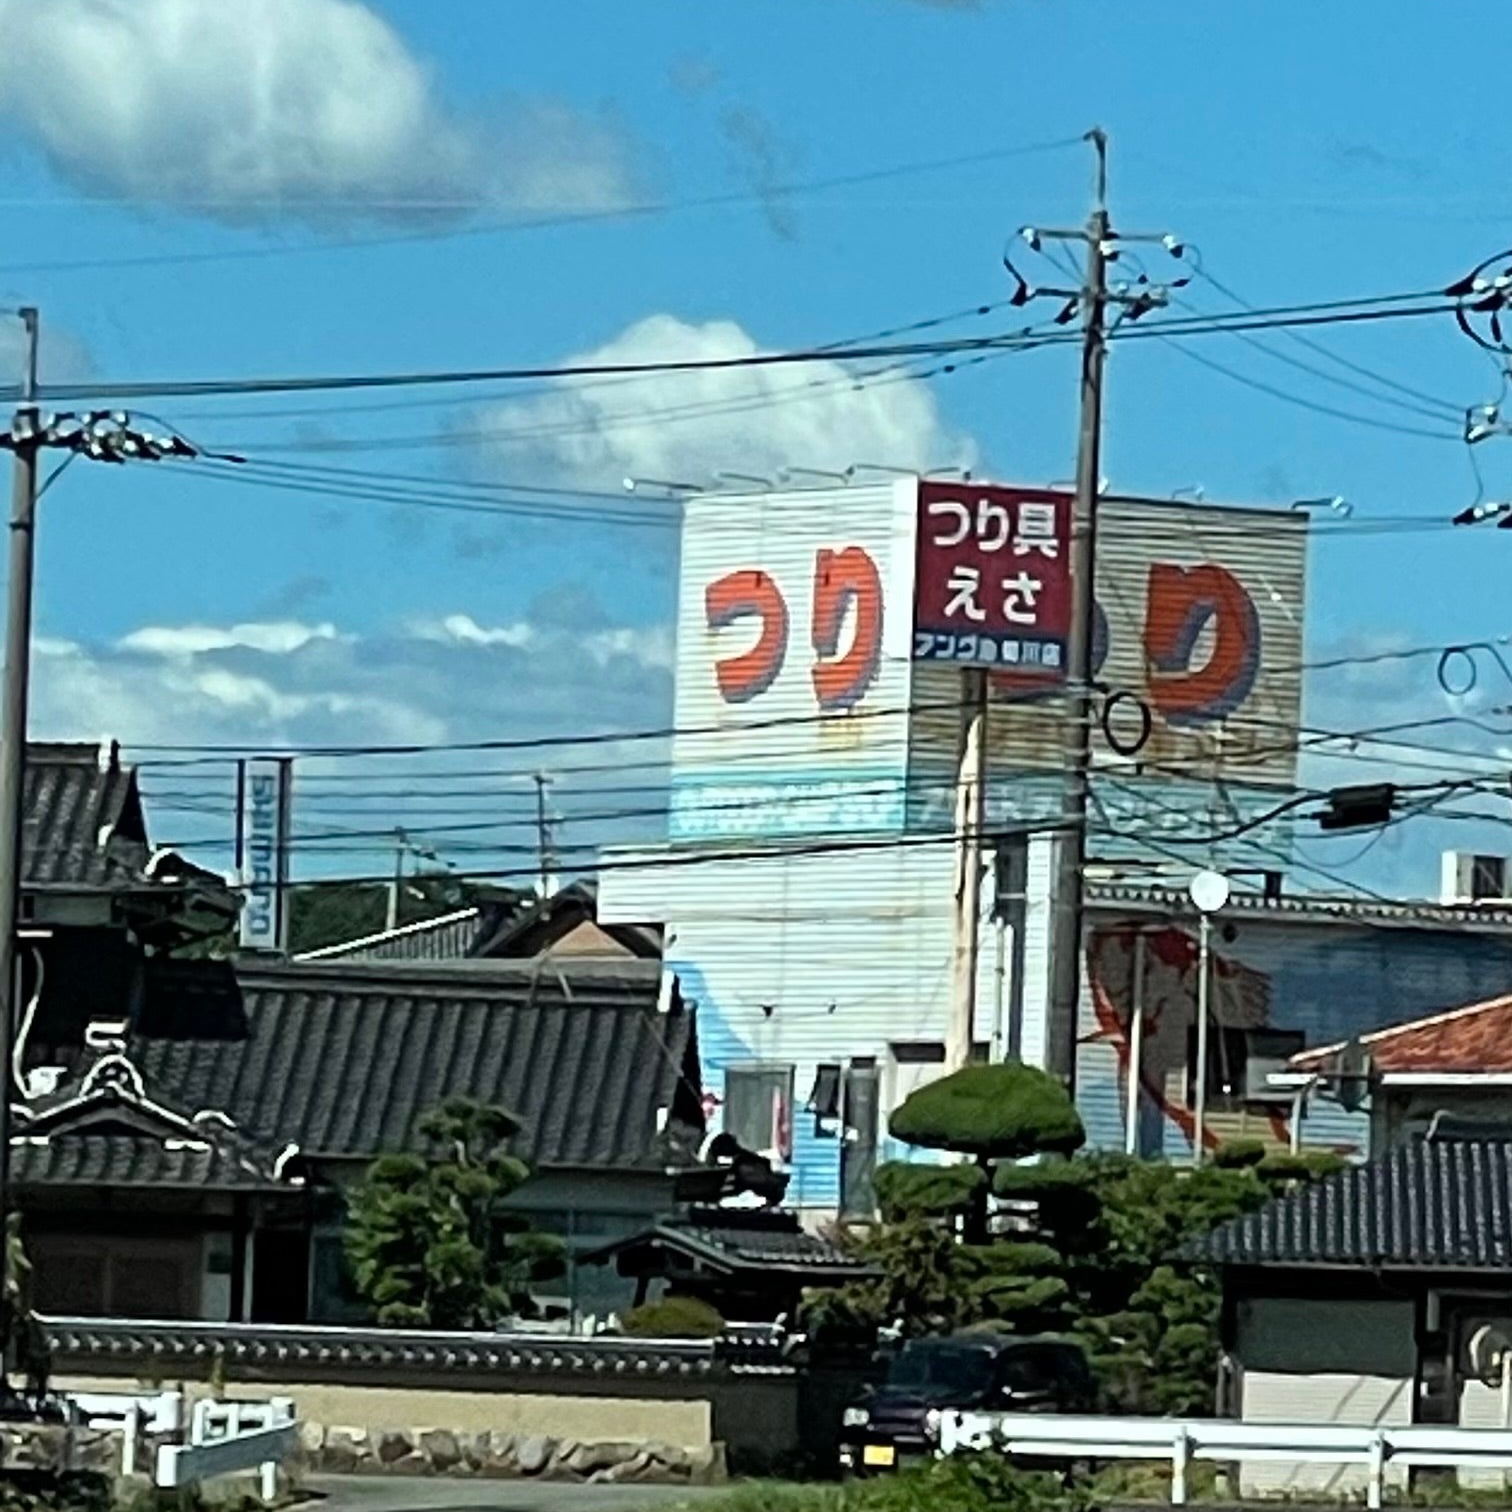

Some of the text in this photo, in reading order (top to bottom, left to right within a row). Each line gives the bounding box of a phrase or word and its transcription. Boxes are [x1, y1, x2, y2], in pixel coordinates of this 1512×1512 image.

[928, 499, 1059, 558] つり具
[944, 566, 1042, 625] えさ
[705, 546, 883, 709] つり
